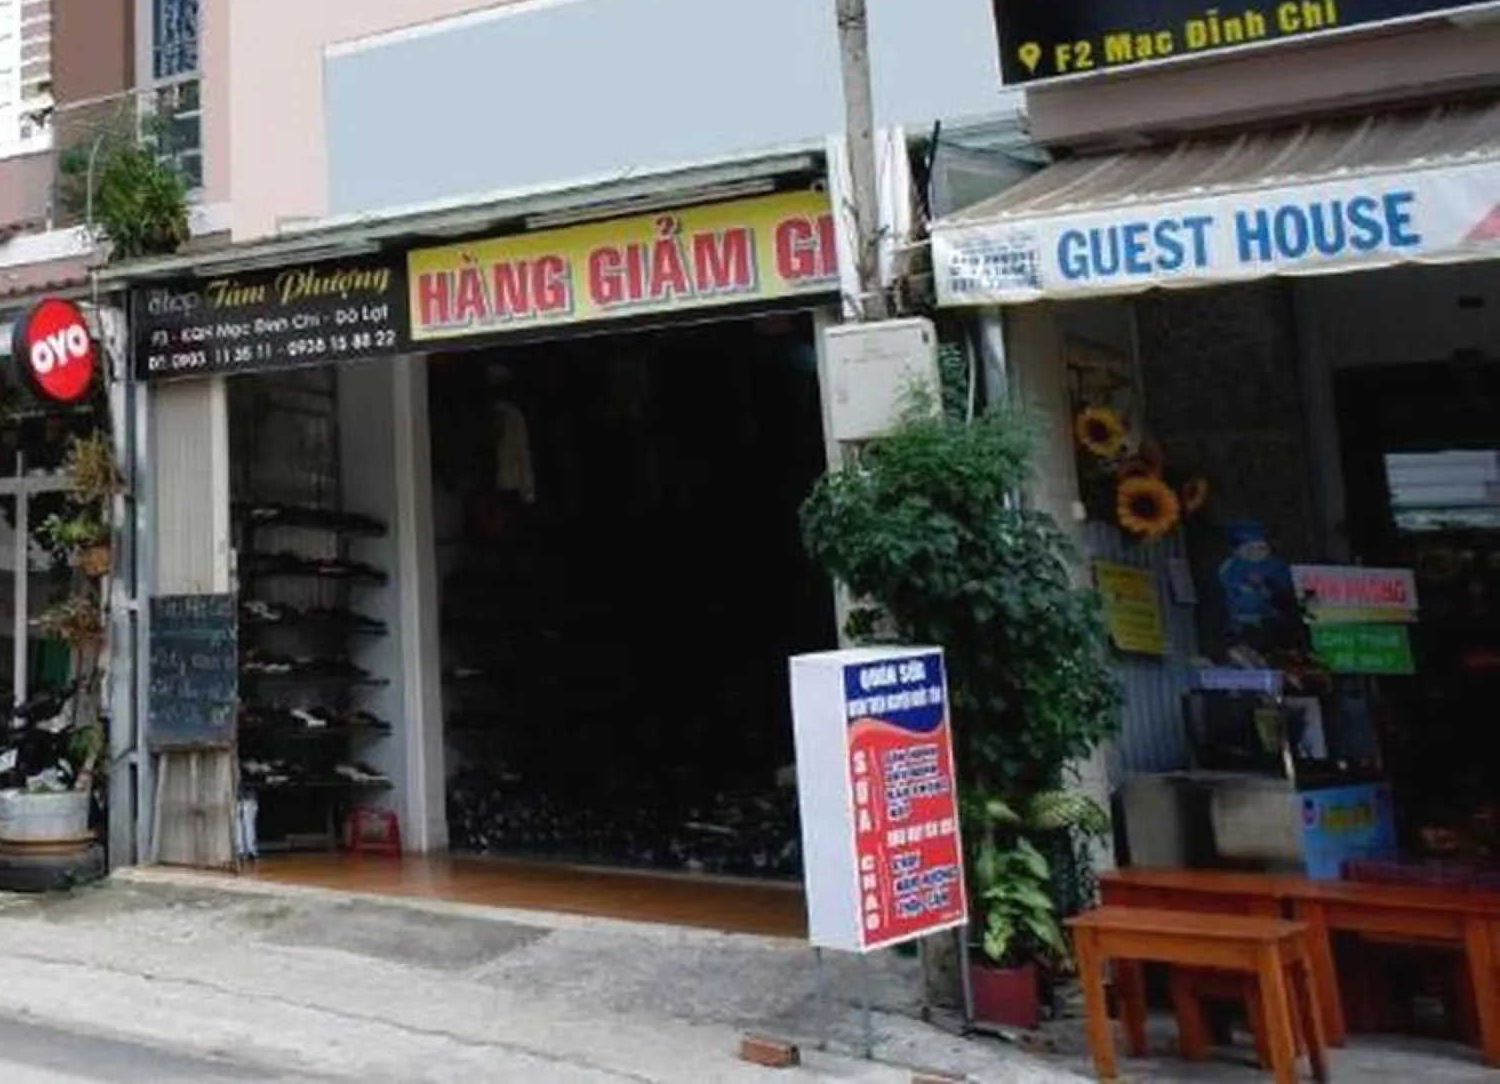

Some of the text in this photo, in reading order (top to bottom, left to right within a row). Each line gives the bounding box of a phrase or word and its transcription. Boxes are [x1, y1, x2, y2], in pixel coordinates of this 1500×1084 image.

[1054, 40, 1093, 72] F2
[1056, 215, 1214, 280] GUEST
[1234, 190, 1423, 263] HOUSE
[417, 250, 572, 328] HÀNG
[587, 215, 758, 307] GIẢM
[31, 323, 90, 374] OYO
